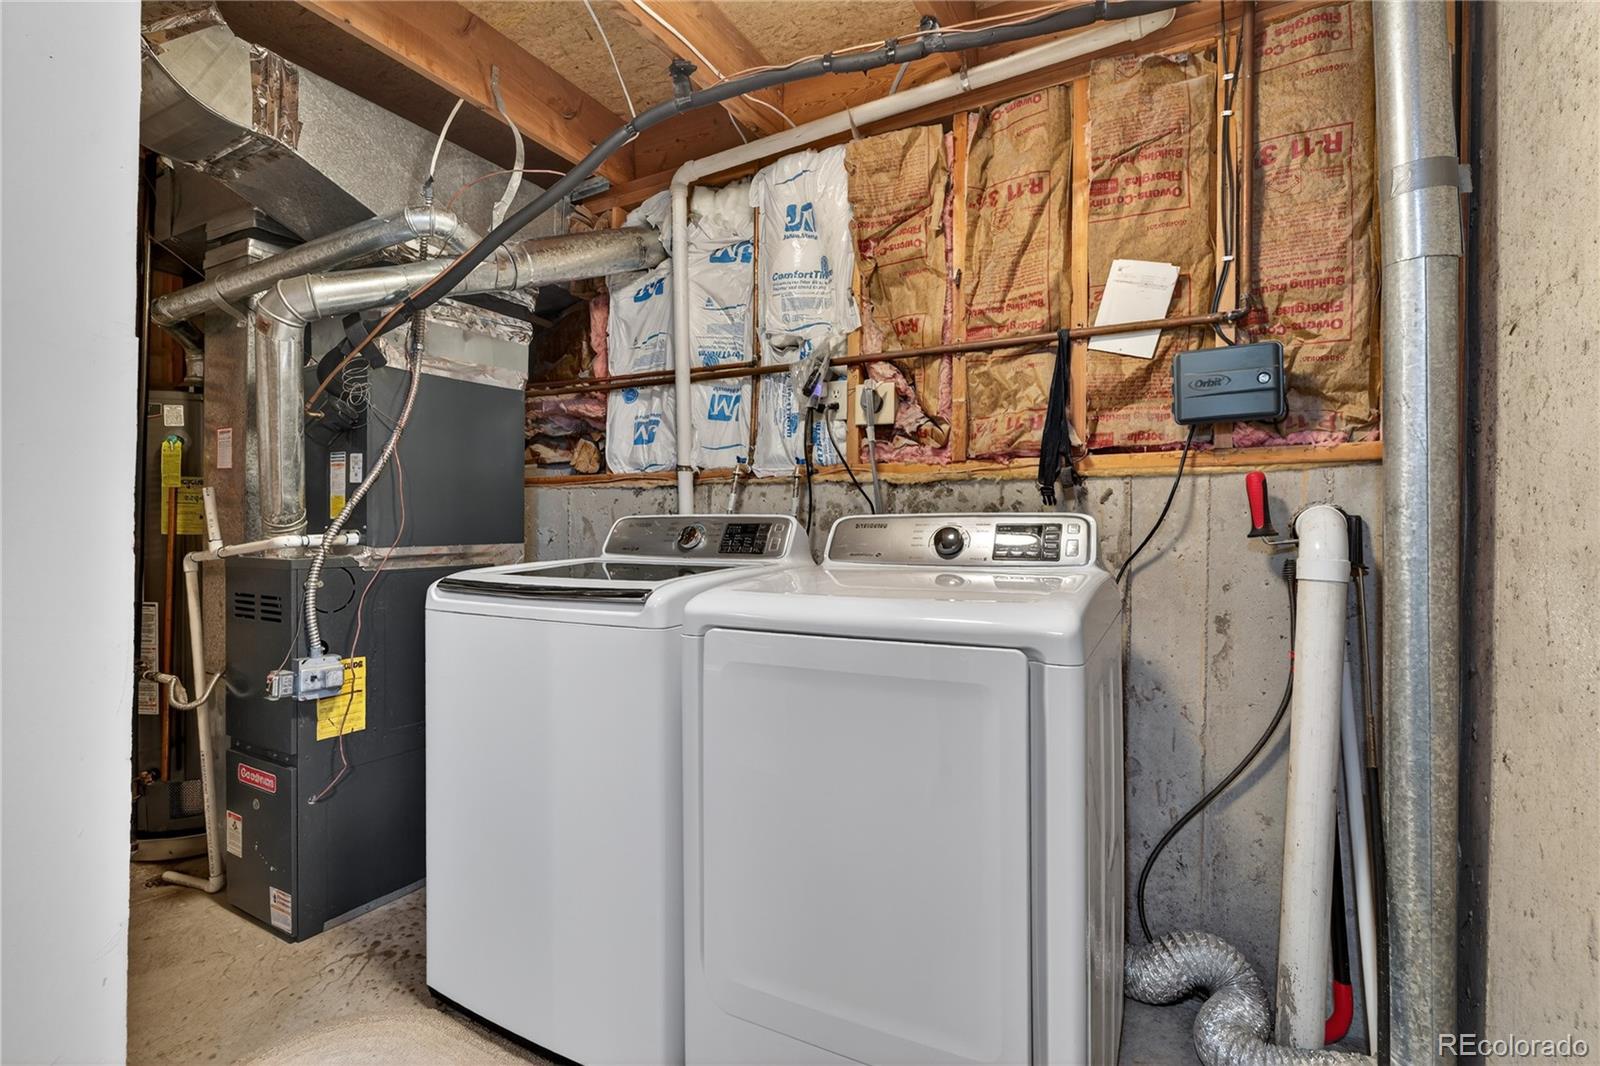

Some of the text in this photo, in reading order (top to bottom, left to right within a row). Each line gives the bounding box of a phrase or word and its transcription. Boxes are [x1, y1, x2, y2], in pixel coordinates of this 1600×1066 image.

[1290, 130, 1343, 160] R-11
[1289, 274, 1345, 296] Building
[1275, 300, 1345, 318] Fiberglas
[1195, 376, 1222, 389] Orbit
